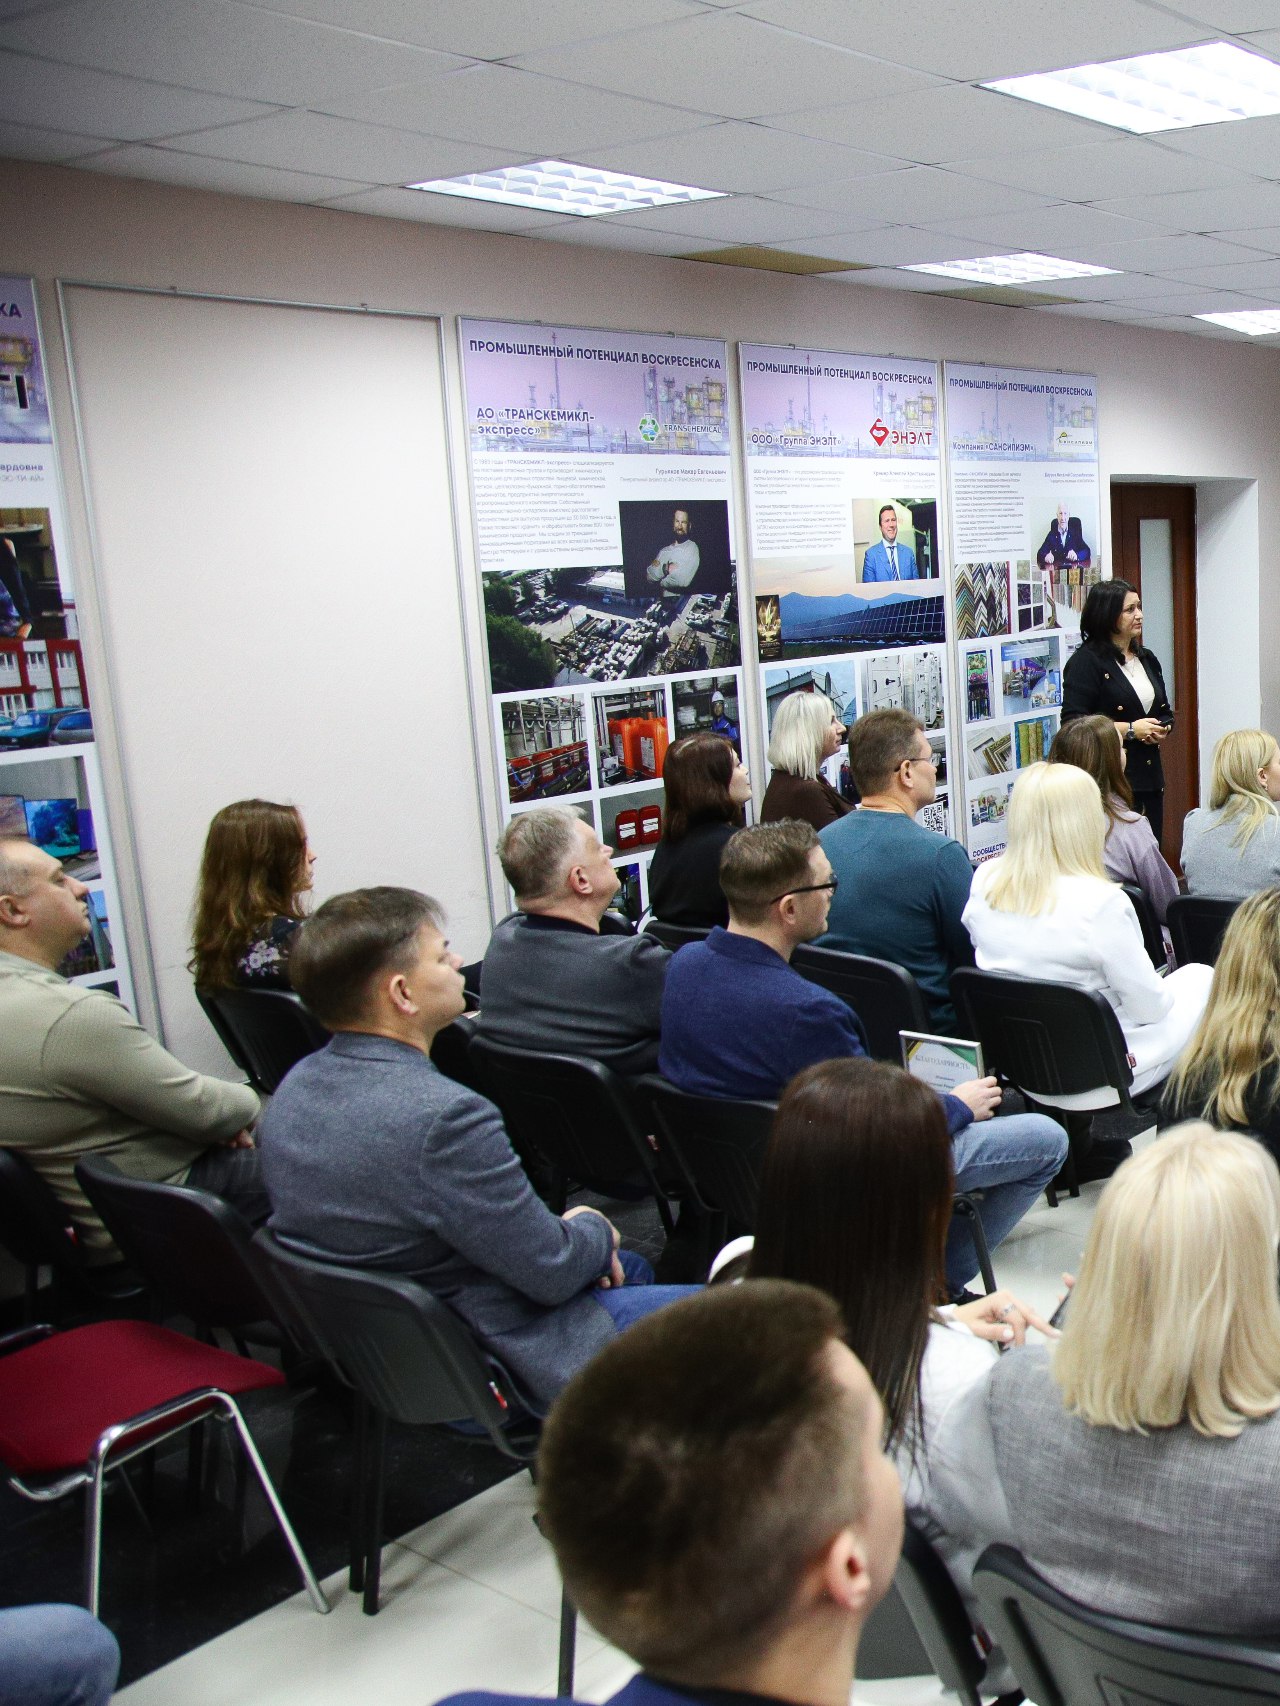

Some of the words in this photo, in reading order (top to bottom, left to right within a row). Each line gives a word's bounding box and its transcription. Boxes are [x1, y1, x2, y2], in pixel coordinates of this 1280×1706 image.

[470, 340, 574, 358] ПРОМЫШЛЕННЫЙ
[577, 348, 639, 364] ПОТЕНЦИАЛ
[643, 353, 721, 369] ВОСКРЕСЕНСКА
[747, 361, 823, 376] ПРОМЫШЛЕННЫЙ
[825, 367, 871, 380] ПОТЕНЦИАЛ
[873, 372, 933, 385] ВОСКРЕСЕНСКА
[949, 378, 1008, 391] ПРОМЫШЛЕННЫЙ
[1008, 382, 1045, 394] ПОТЕНЦИАЛ
[1045, 385, 1093, 397] ВОСКРЕСЕНСКА
[477, 408, 495, 418] АО
[499, 408, 595, 422] «ТРАНСКЕМИКЛ-
[478, 426, 543, 437] экспресс»
[664, 424, 722, 434] TRANSCHEMICAL
[752, 434, 773, 444] ООО
[892, 430, 932, 445] ЭНЭЛТ
[972, 842, 1008, 857] СООБЩЕСТВ
